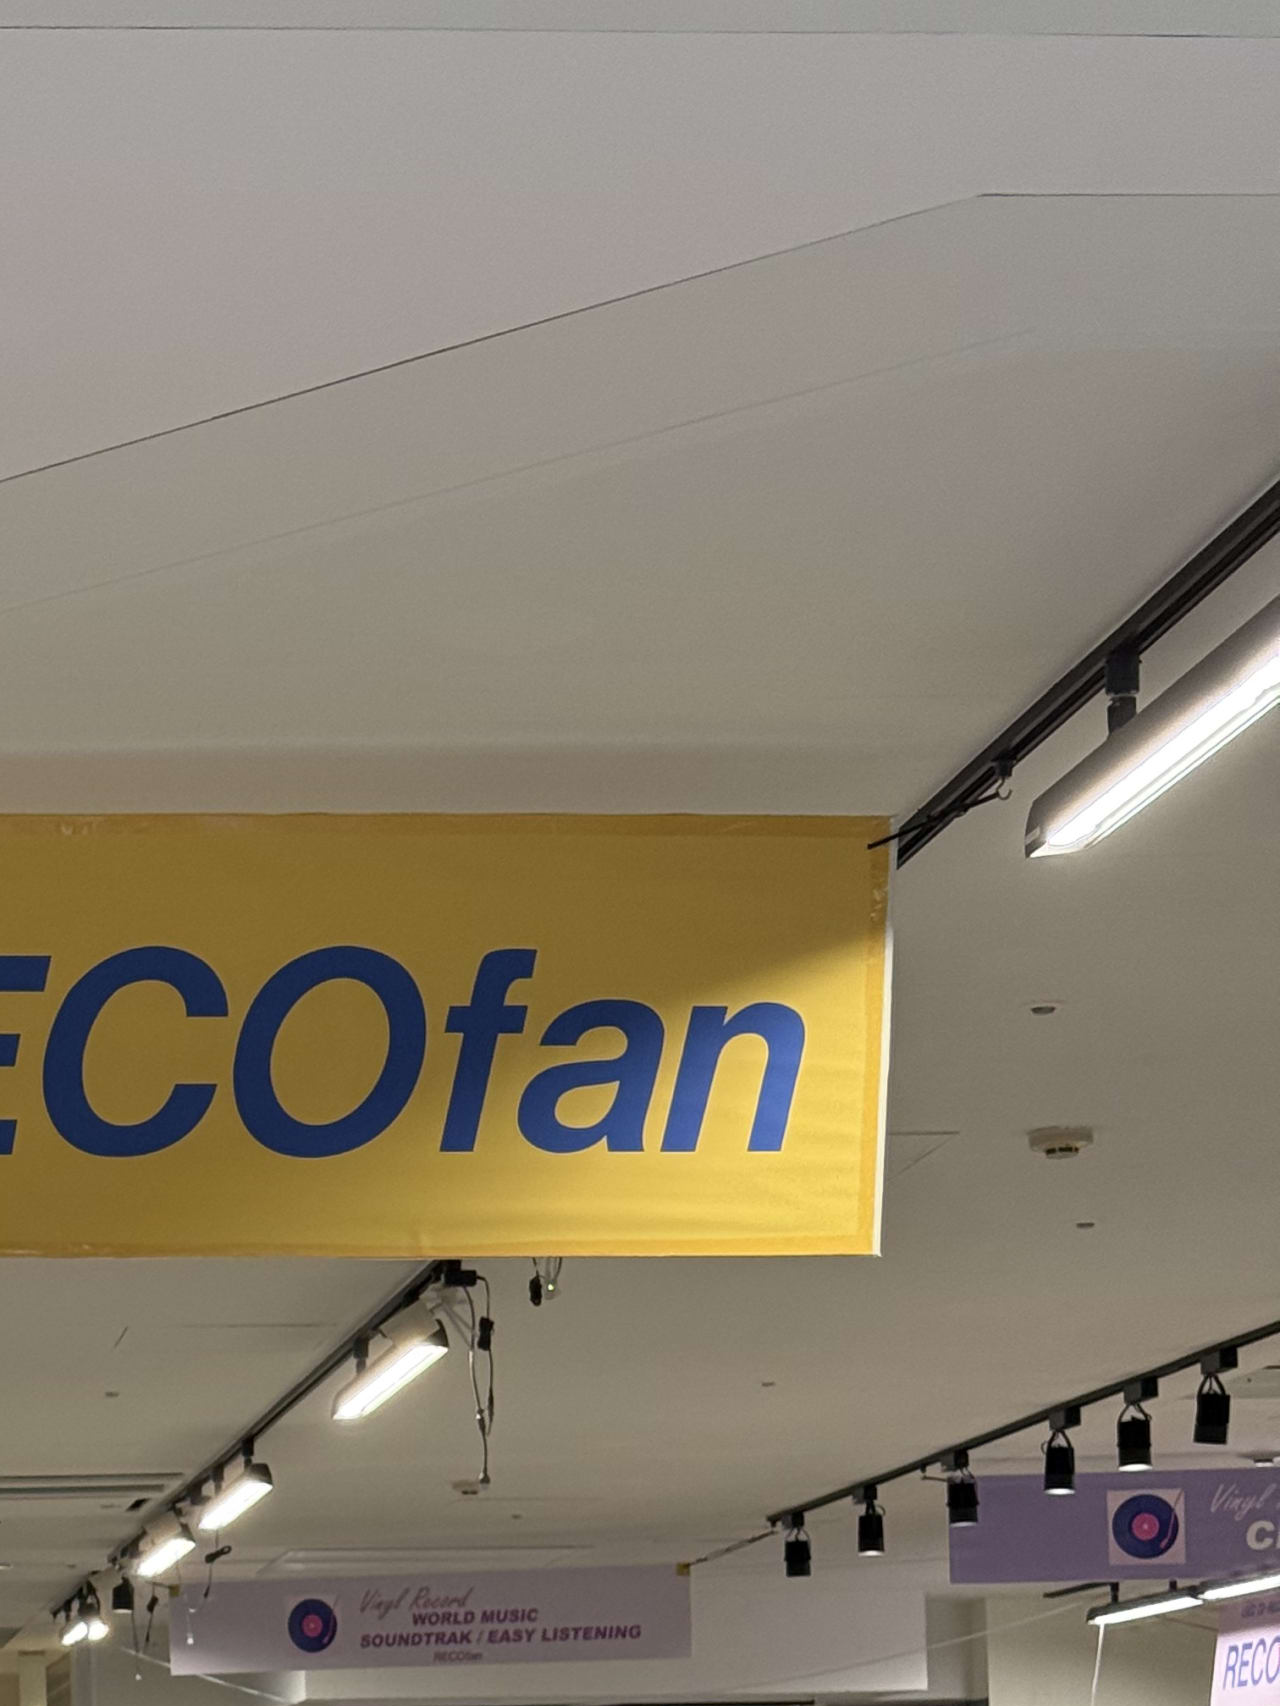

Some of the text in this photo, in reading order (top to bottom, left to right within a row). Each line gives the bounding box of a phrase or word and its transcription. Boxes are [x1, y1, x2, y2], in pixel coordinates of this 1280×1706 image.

[1210, 1483, 1277, 1521] Vinyl
[359, 1587, 476, 1614] Vinyl Record
[411, 1608, 540, 1628] WORLD MUSIC
[359, 1628, 473, 1650] SOUNDTRAK
[487, 1626, 537, 1645] EASY
[541, 1624, 643, 1643] LISTENING
